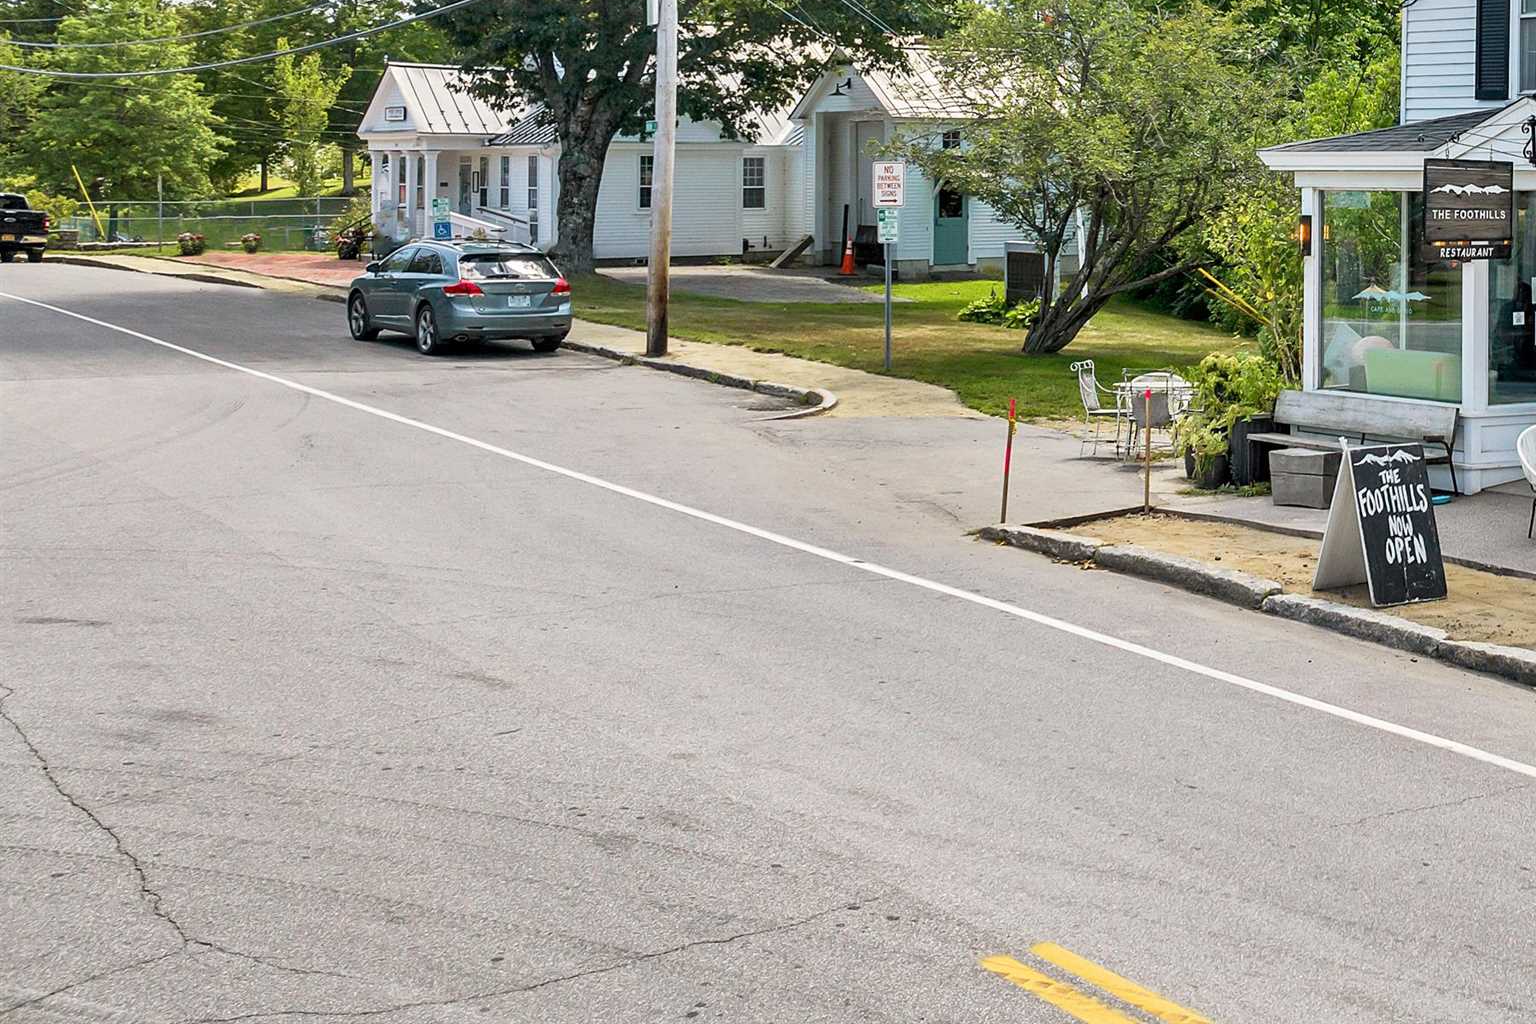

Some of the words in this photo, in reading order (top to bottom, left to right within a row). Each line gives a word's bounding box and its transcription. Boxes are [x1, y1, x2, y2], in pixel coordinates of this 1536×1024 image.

[884, 165, 894, 174] NO
[1432, 209, 1451, 220] THE
[1454, 209, 1506, 220] FOOTHILLS
[1440, 247, 1494, 258] RESTAURANT
[1378, 468, 1400, 484] THE
[1358, 484, 1428, 517] FOOTHILLS
[1388, 515, 1413, 536] NOW
[1385, 534, 1427, 564] OPEN
